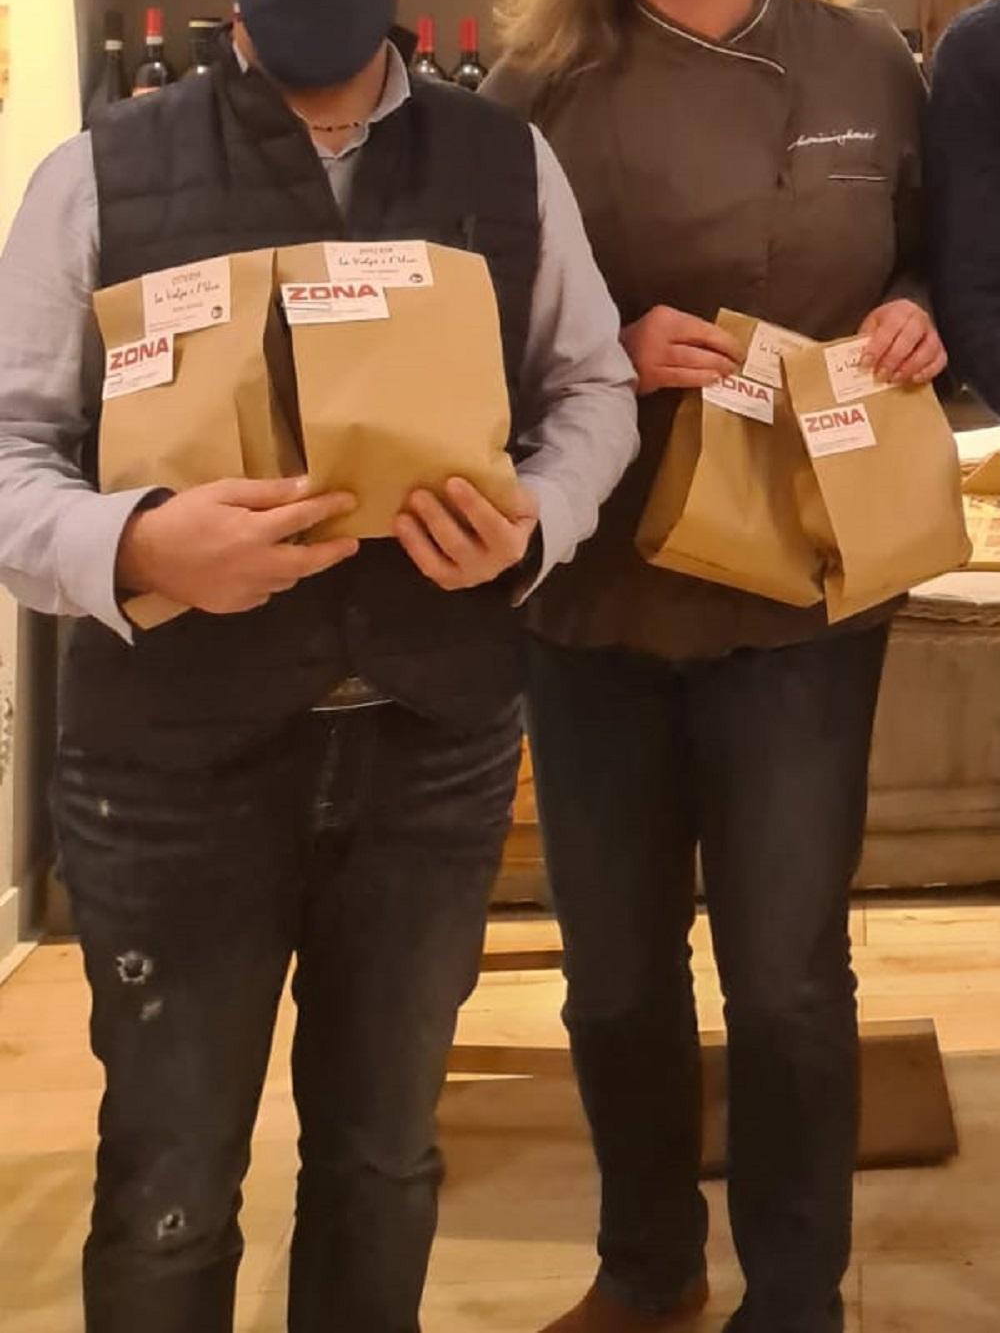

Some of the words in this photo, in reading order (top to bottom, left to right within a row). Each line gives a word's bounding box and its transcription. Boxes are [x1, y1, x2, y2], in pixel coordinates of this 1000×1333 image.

[287, 284, 378, 301] ZONA
[110, 336, 169, 371] ZONA
[804, 408, 866, 433] ZONA
